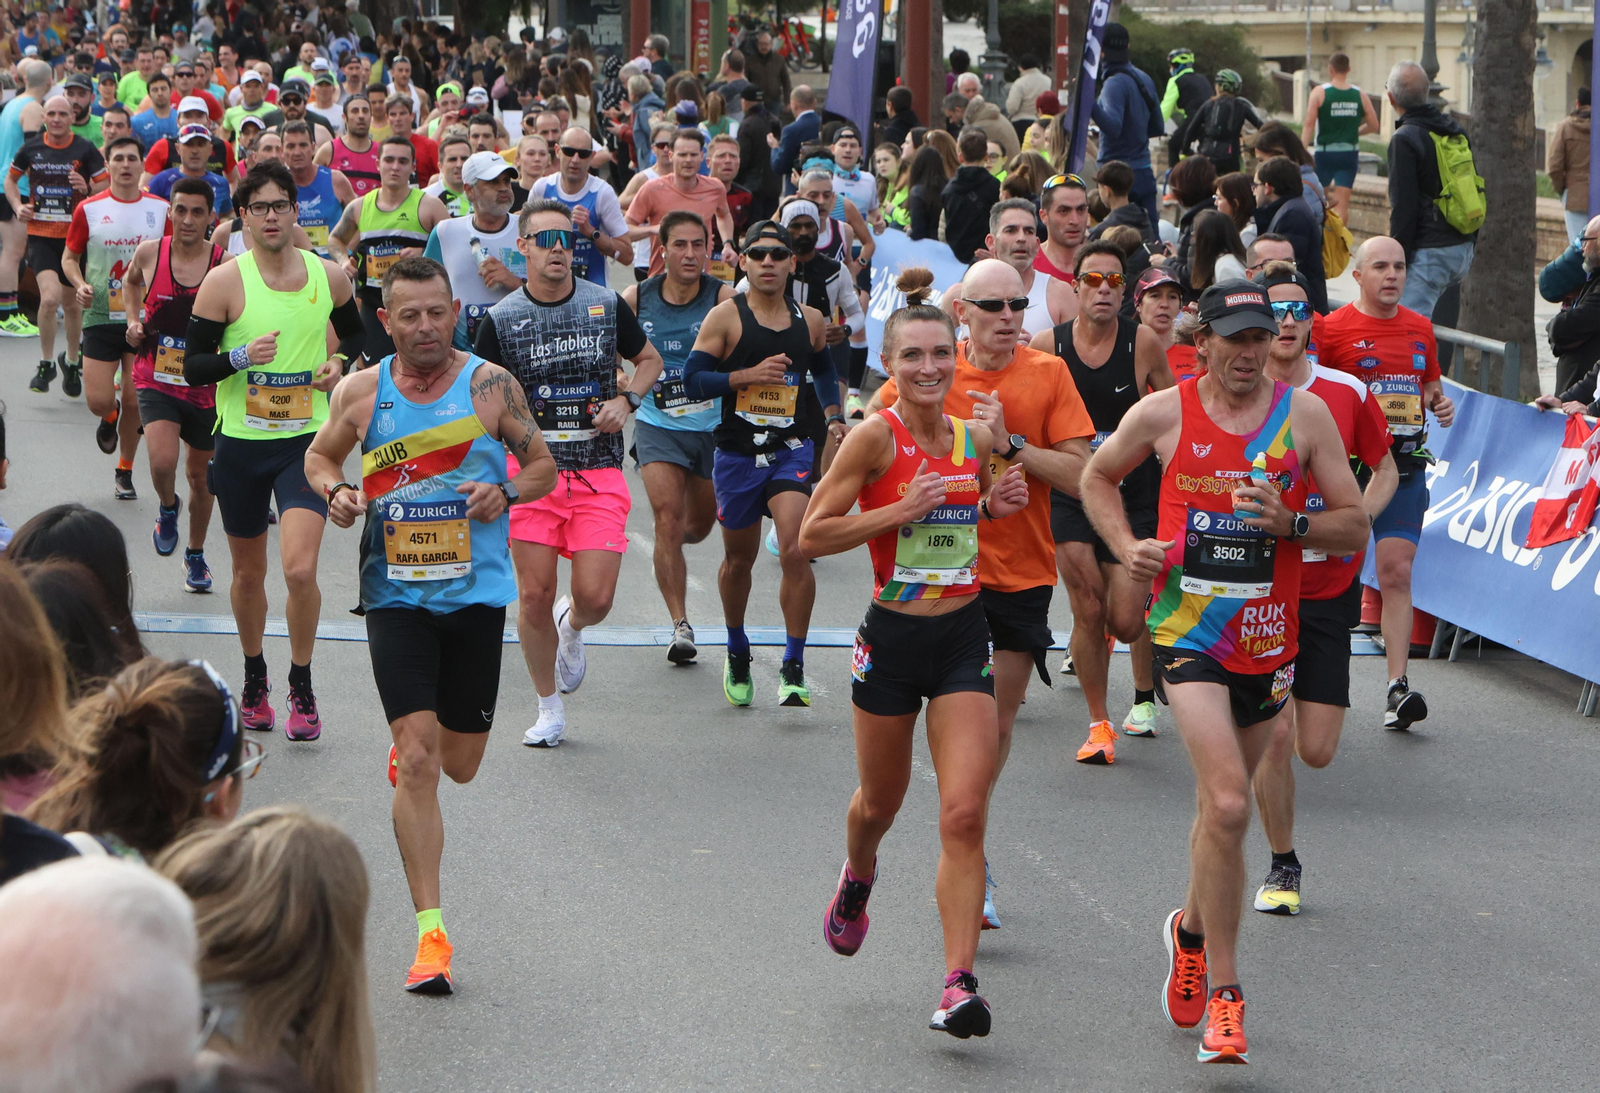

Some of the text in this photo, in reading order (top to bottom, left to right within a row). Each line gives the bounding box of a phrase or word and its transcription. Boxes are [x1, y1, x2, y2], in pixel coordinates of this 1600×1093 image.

[698, 19, 709, 58] PASEO
[375, 261, 391, 270] 4123
[1226, 294, 1263, 305] MODBALLS
[530, 333, 595, 360] Las Tablas
[163, 365, 180, 375] PACO
[271, 374, 305, 385] ZURICH
[555, 385, 593, 396] ZURICH
[671, 384, 685, 395] 315
[1386, 383, 1415, 393] ZURICH
[269, 394, 292, 405] 4200
[758, 391, 780, 401] 4153
[555, 405, 580, 416] 3218
[749, 404, 786, 415] LEONARDO
[1386, 400, 1407, 410] 3698
[269, 410, 291, 419] MASE
[374, 441, 408, 469] CLUB
[1175, 473, 1200, 494] City
[1304, 497, 1324, 508] ICH
[408, 505, 458, 518] ZURICH
[931, 509, 972, 520] ZURICH
[409, 532, 438, 545] 4571
[927, 535, 954, 547] 1876
[396, 551, 459, 564] RAFA GARCIA
[1212, 545, 1246, 561] 3502
[1241, 602, 1287, 625] RUN
[1240, 620, 1286, 640] NING
[1238, 630, 1287, 656] Team
